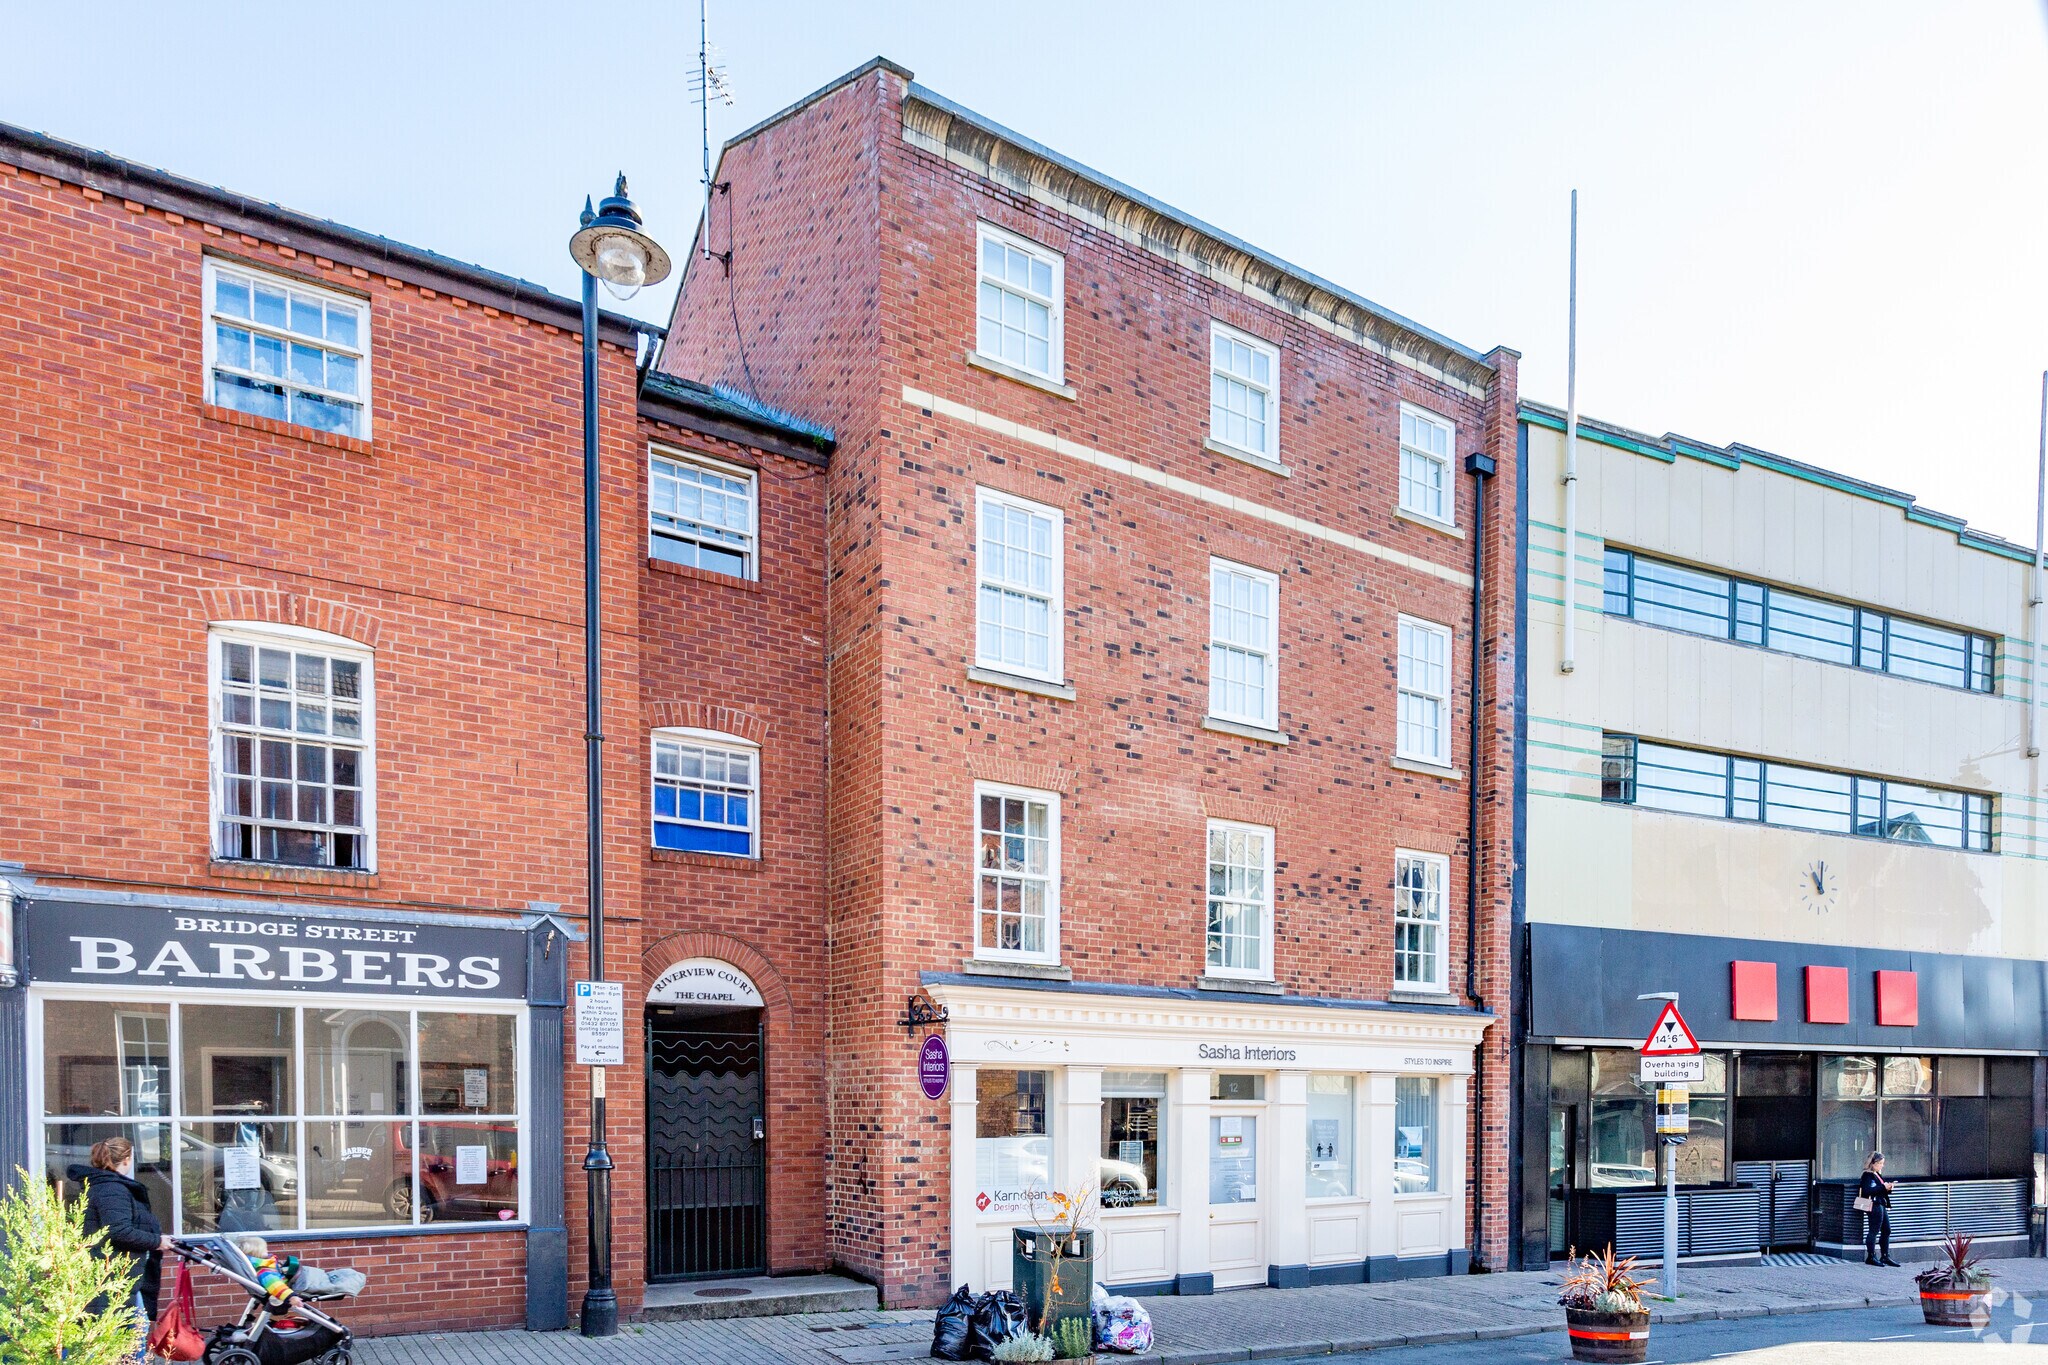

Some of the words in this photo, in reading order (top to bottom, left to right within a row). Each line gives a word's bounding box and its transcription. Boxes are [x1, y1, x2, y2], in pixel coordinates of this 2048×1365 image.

[175, 916, 298, 938] BRIDGE
[305, 925, 416, 944] STREET
[69, 935, 500, 990] BARBERS
[654, 968, 716, 993] RIVERVIEW
[718, 970, 754, 996] COURT
[675, 991, 695, 1000] THE
[696, 992, 735, 1001] CHAPEL
[925, 1048, 943, 1060] Sasha
[1198, 1043, 1240, 1060] Sasha
[1244, 1045, 1297, 1061] Interiors
[923, 1061, 945, 1072] Interiors
[1404, 1057, 1424, 1066] STYLES
[1654, 1070, 1689, 1078] building
[1228, 1082, 1238, 1092] 12
[341, 1146, 373, 1157] BARBER
[994, 1190, 1047, 1202] Karndean
